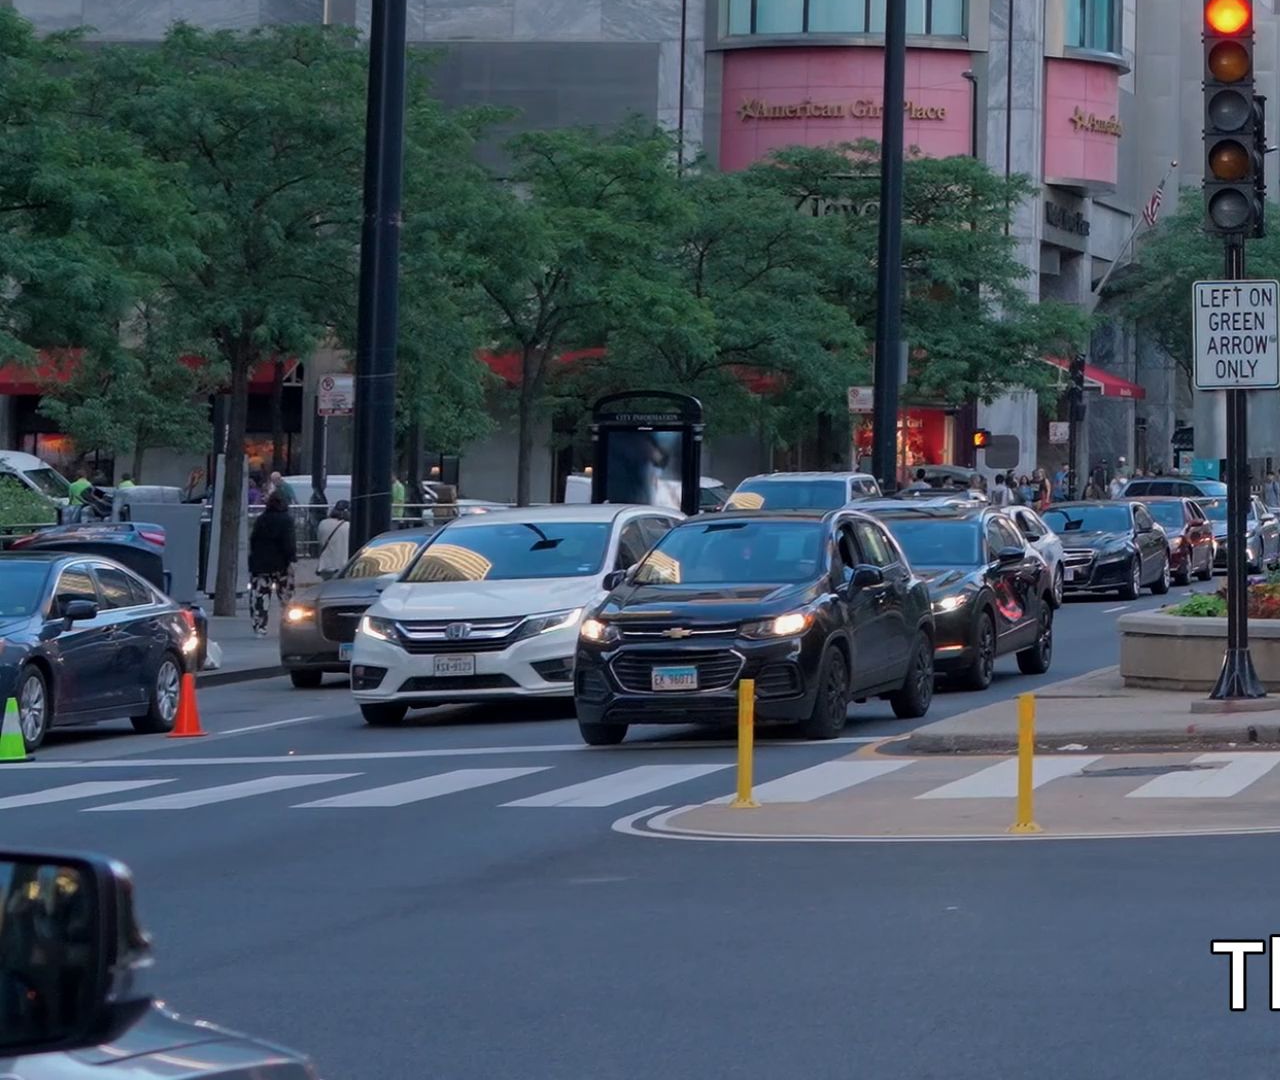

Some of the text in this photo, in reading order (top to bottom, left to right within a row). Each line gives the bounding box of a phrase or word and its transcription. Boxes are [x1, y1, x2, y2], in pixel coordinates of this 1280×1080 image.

[754, 98, 846, 119] American
[850, 99, 884, 119] Gir
[1200, 287, 1272, 307] LEFT ON
[1209, 311, 1265, 331] GREEN
[1207, 335, 1267, 355] ARROW
[1216, 360, 1258, 379] ONLY
